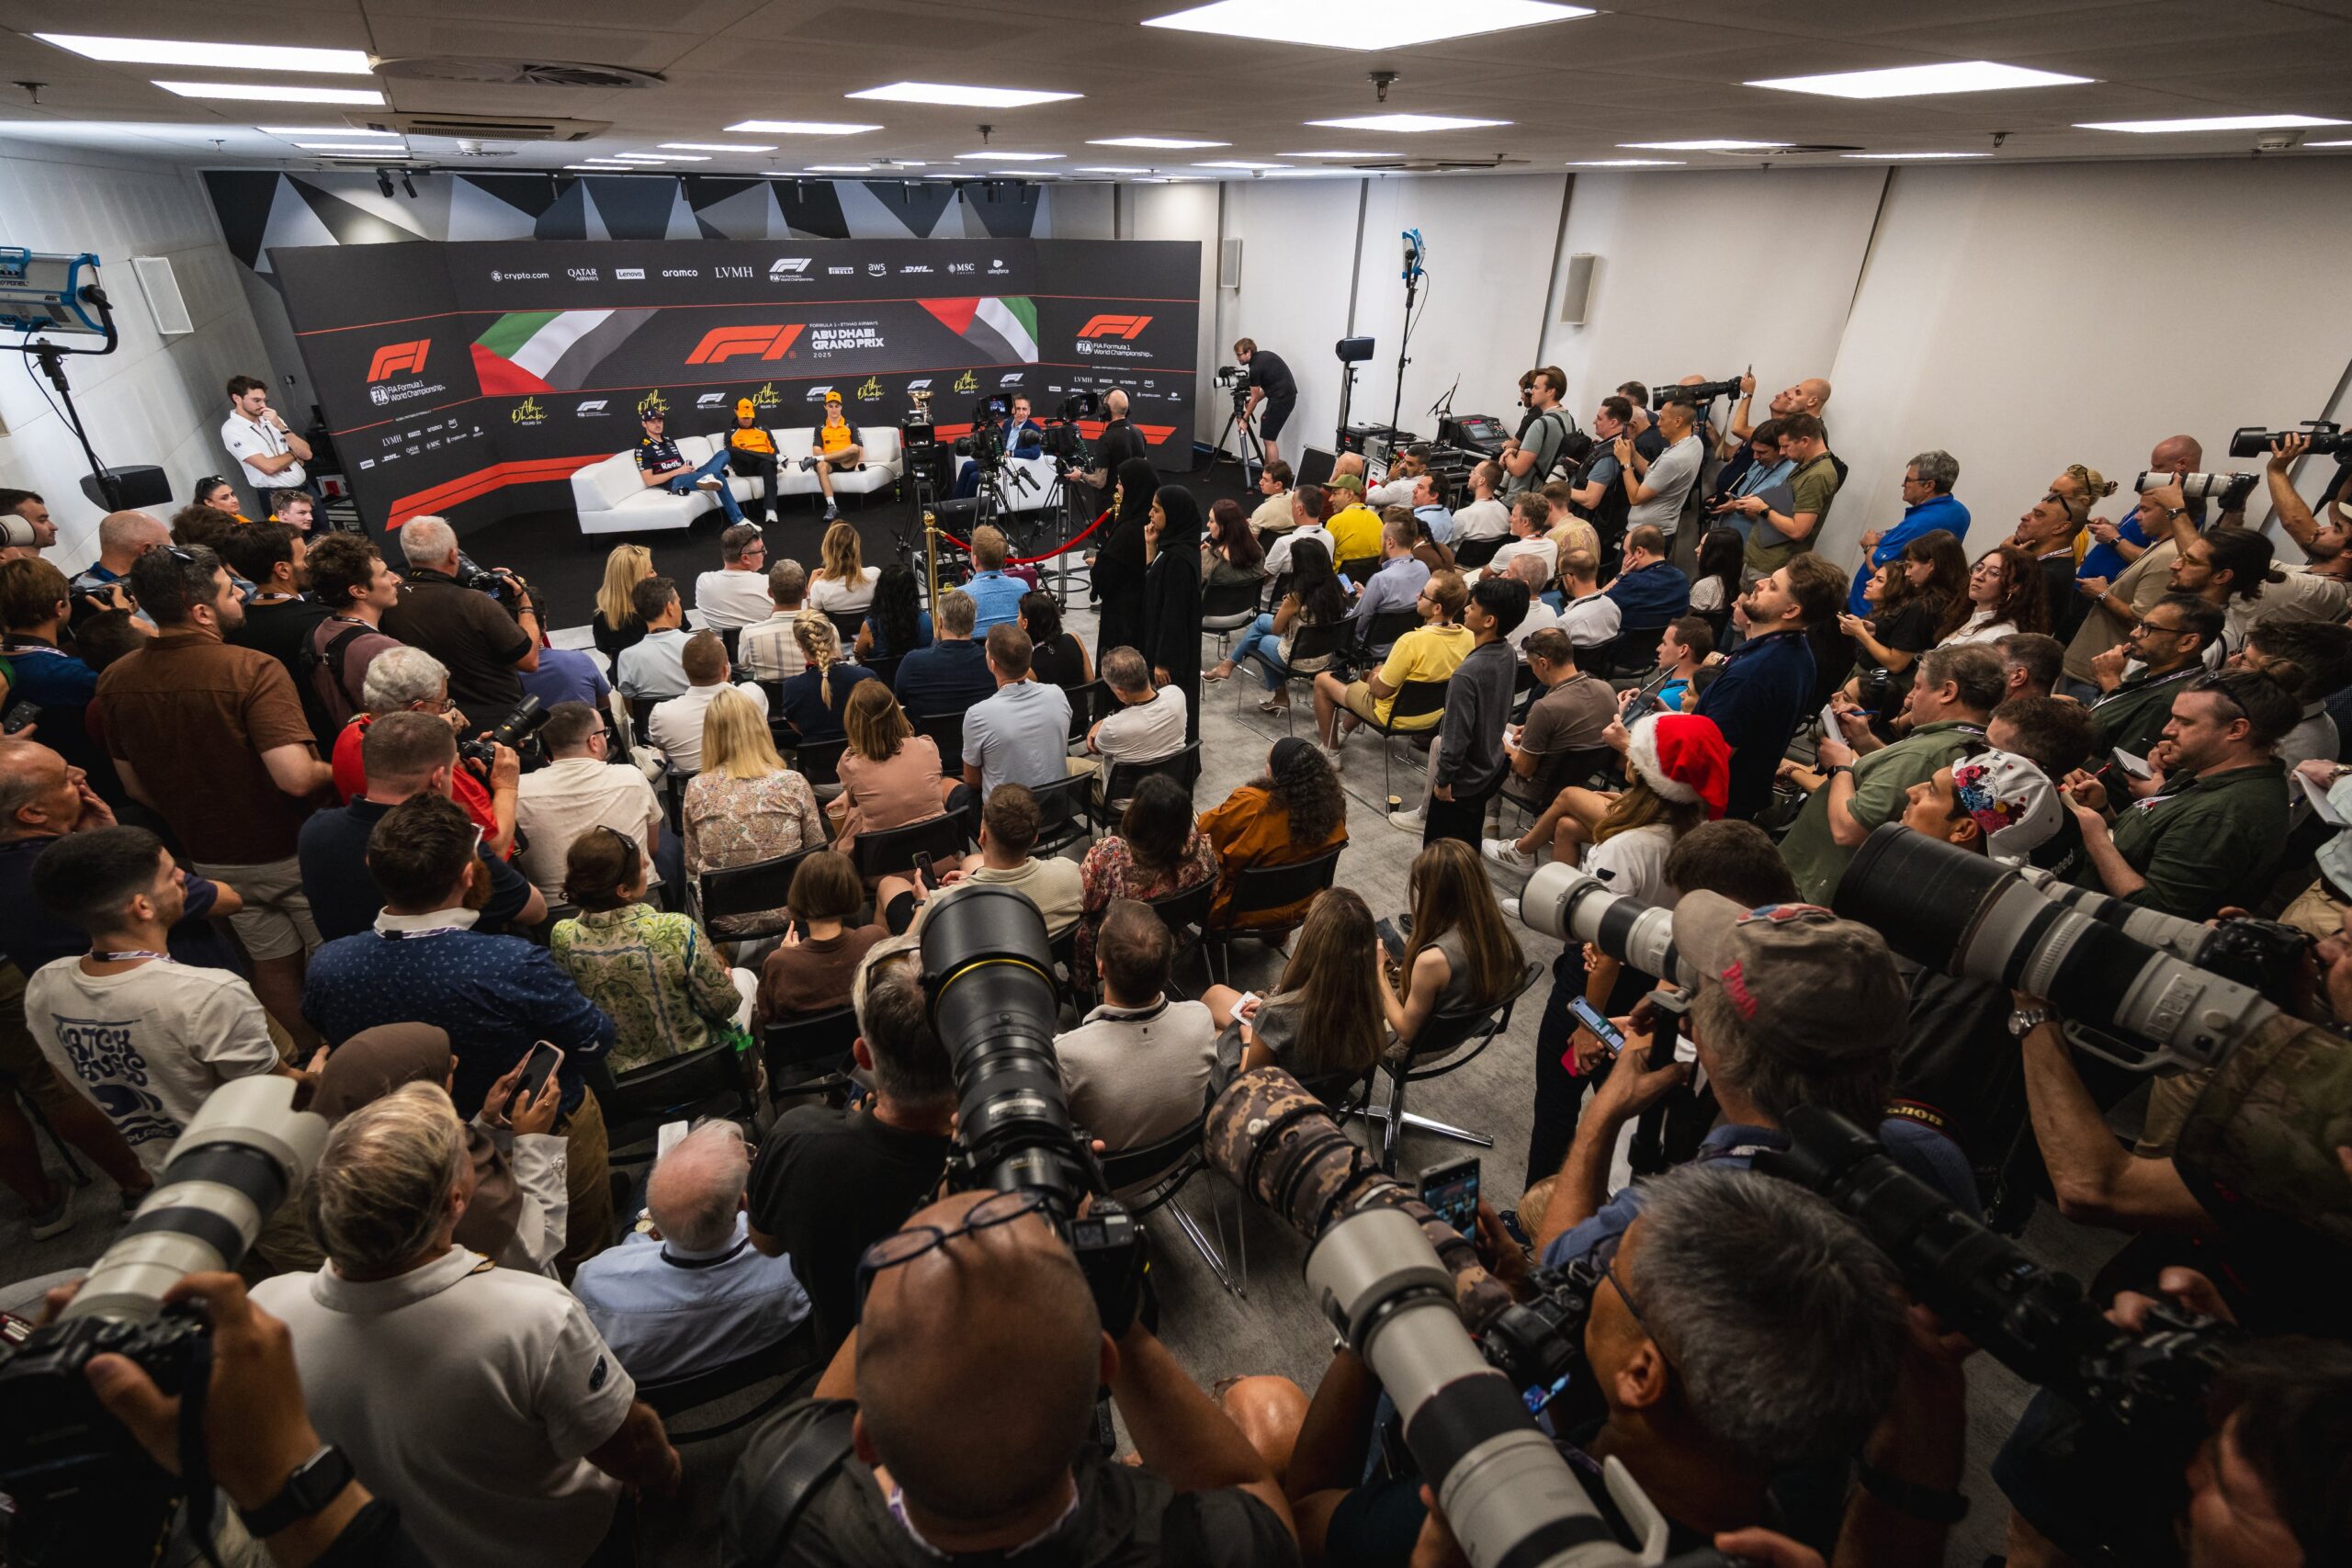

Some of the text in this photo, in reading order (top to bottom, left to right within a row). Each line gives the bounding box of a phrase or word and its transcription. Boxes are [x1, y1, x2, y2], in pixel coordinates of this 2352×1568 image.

[568, 268, 597, 277] QATAR
[715, 266, 753, 278] LVMH
[829, 266, 854, 275] PIRELLI
[956, 263, 975, 271] MSC
[504, 272, 549, 280] crypto.com
[811, 328, 876, 341] ABU DHABI
[812, 337, 885, 350] GRAND PRIX
[1111, 349, 1150, 357] Championship
[397, 381, 419, 391] Formula
[759, 381, 779, 399] Abu
[864, 376, 882, 392] Abu
[390, 384, 443, 401] World Championship
[644, 389, 668, 406] Abu
[518, 396, 543, 414] Abu
[752, 393, 783, 406] Dhabi
[638, 400, 670, 415] Dbi
[512, 407, 548, 423] Dhabi
[382, 434, 402, 446] LVMH
[1886, 1106, 1943, 1126] anon
